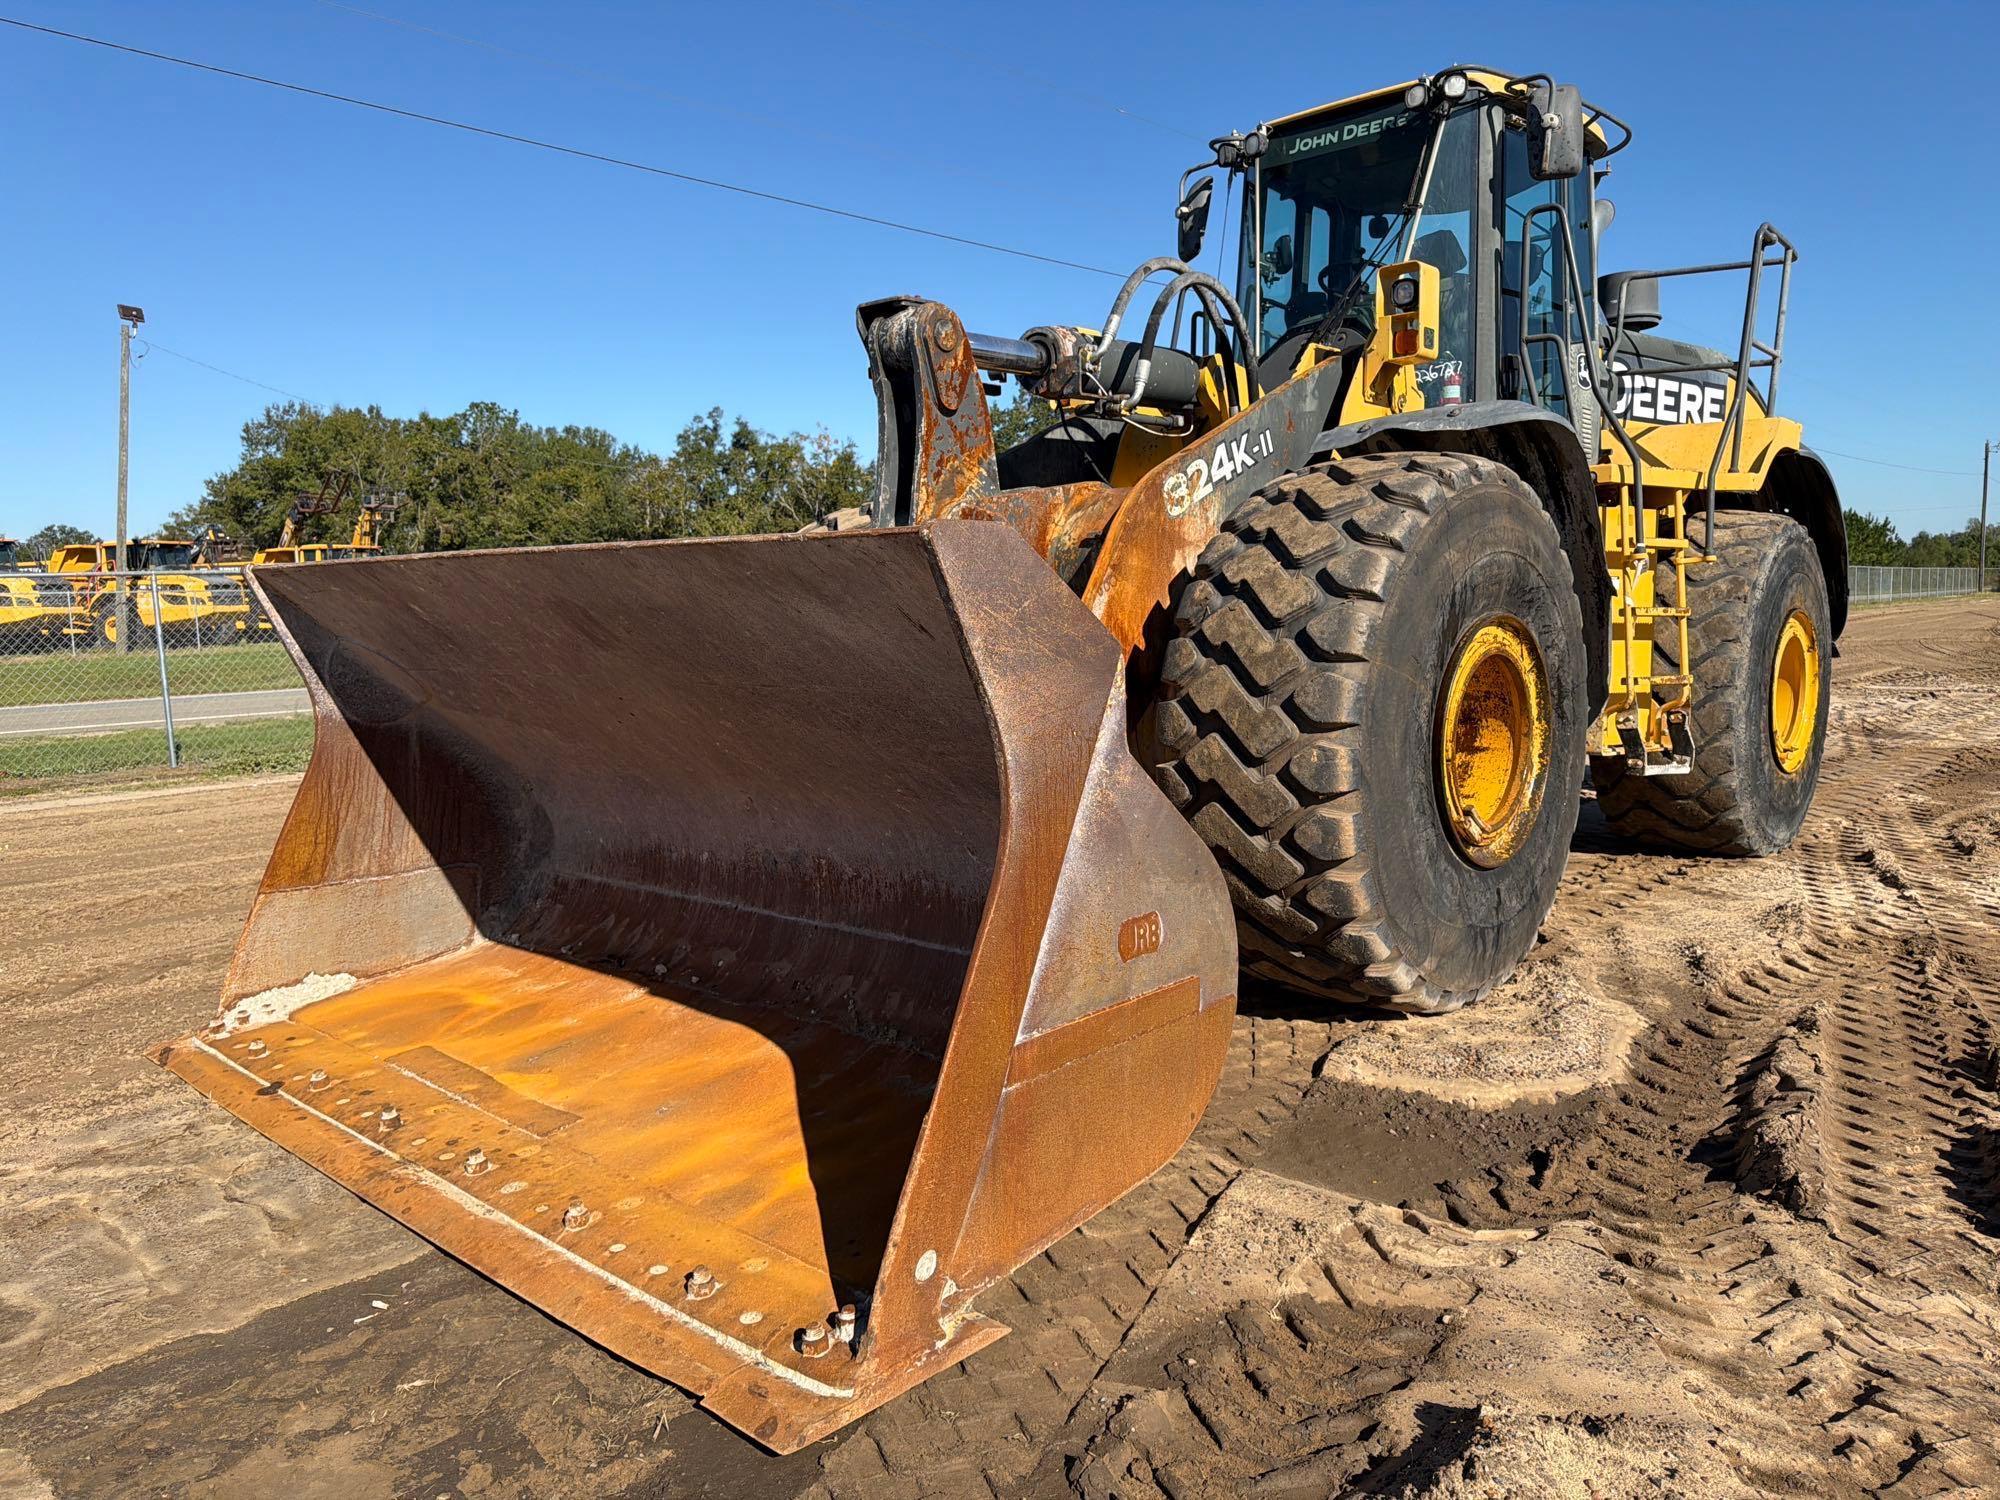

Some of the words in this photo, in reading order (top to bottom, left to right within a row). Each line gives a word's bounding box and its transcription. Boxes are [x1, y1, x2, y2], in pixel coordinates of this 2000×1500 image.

[1289, 130, 1339, 155] JOHN
[1342, 112, 1408, 141] DEERE
[1163, 428, 1274, 516] 824K-II
